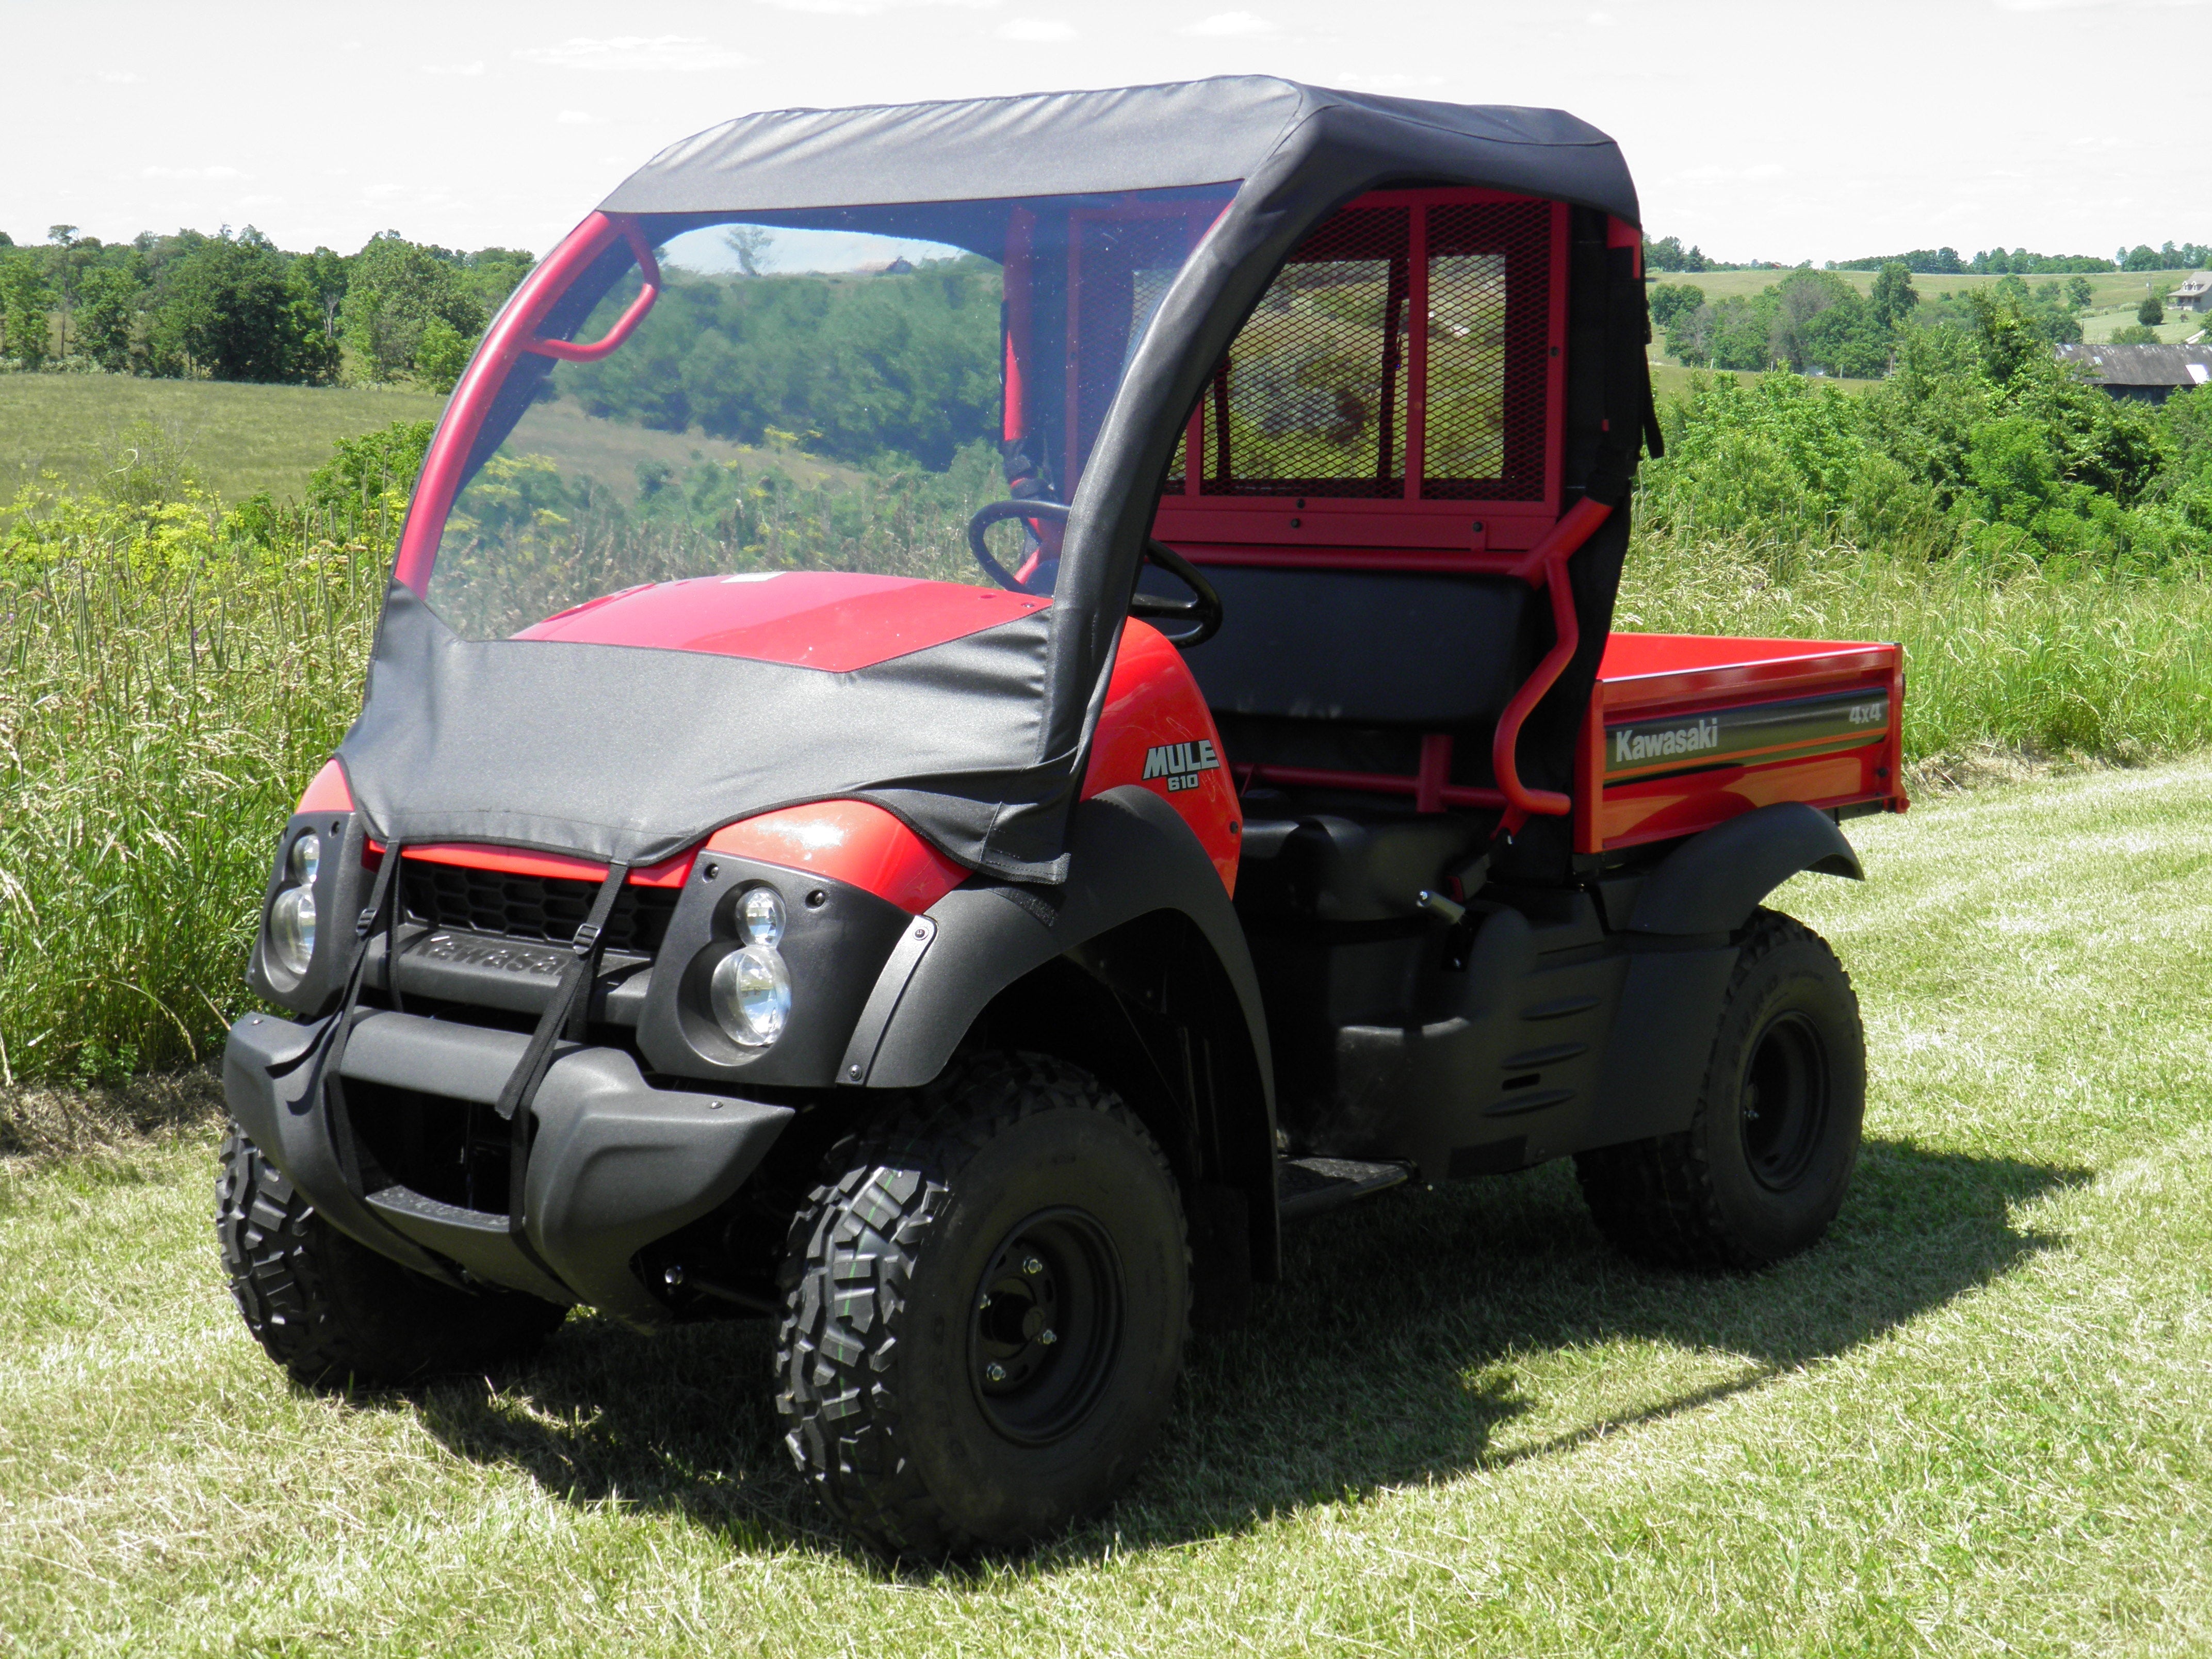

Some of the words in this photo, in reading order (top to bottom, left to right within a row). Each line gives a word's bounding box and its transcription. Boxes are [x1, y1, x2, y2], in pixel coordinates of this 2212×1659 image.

[1849, 703, 1882, 724] 4x4
[1143, 739, 1220, 779] MULE
[1616, 718, 1717, 762] Kawasaki
[1167, 774, 1198, 791] 610
[417, 935, 565, 977] Kawasa
